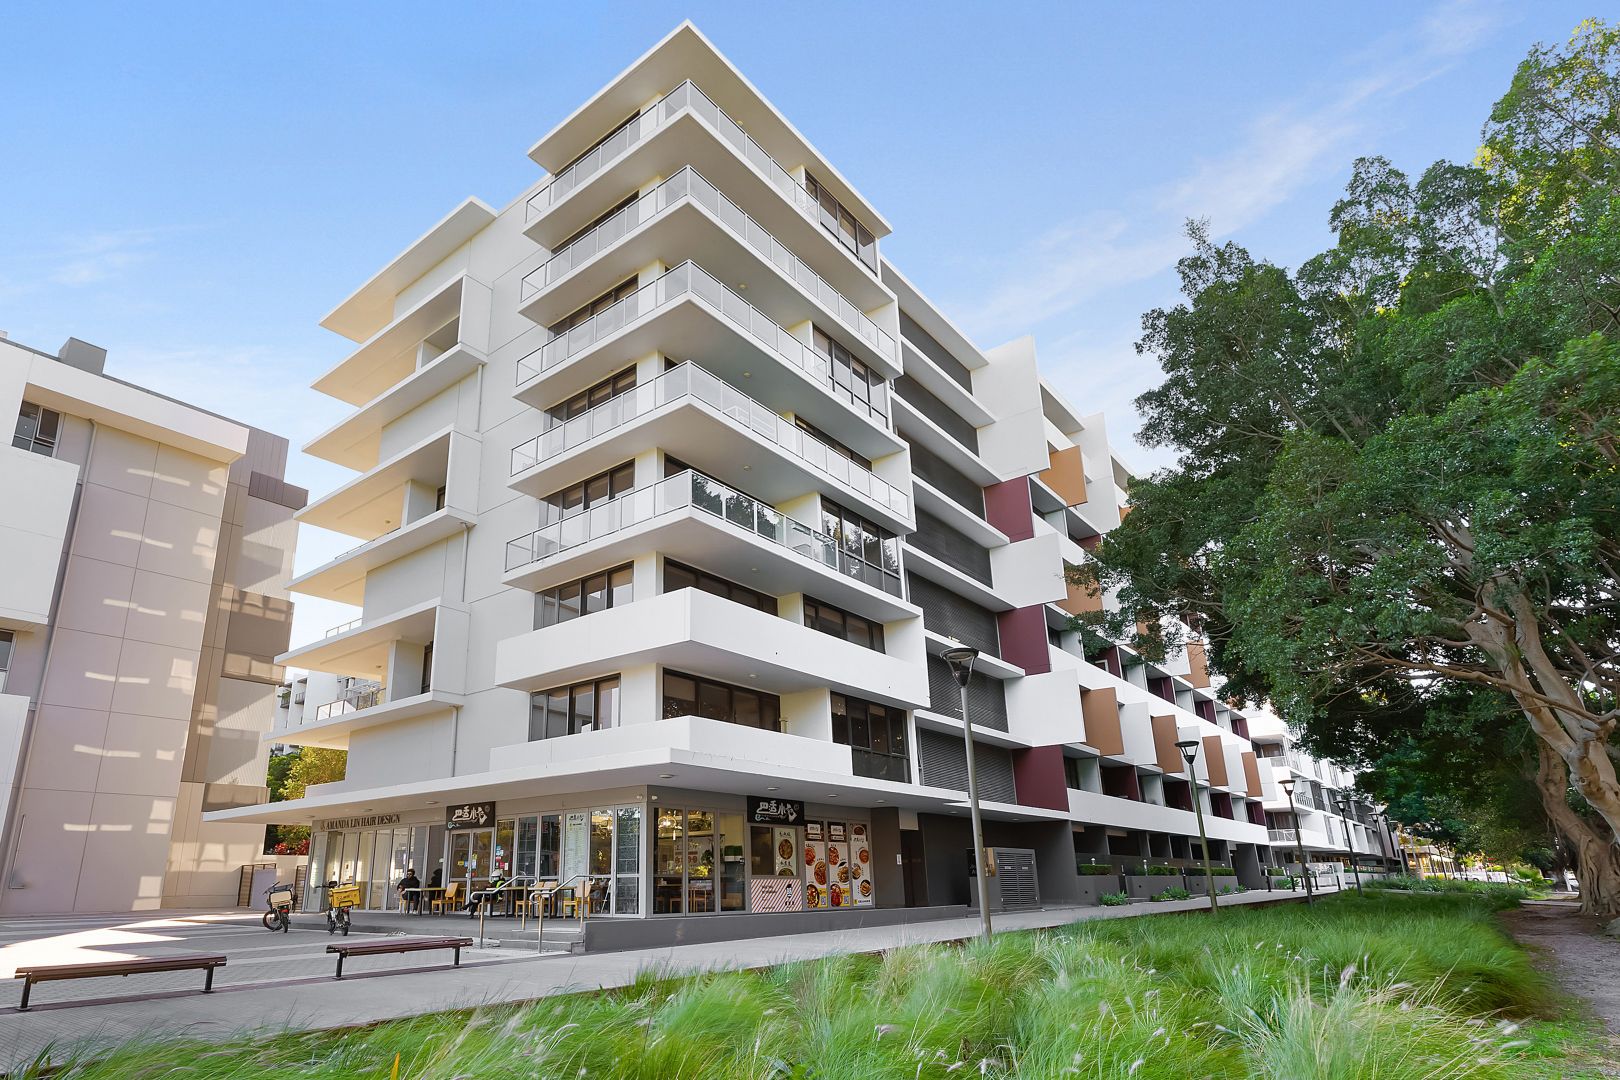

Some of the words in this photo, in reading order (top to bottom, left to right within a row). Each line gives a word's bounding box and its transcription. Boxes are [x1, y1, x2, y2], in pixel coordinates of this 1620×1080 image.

[326, 819, 350, 830] AMANDA
[350, 818, 360, 828] LIN
[361, 816, 376, 827] HAIR
[377, 814, 401, 826] DESIGN
